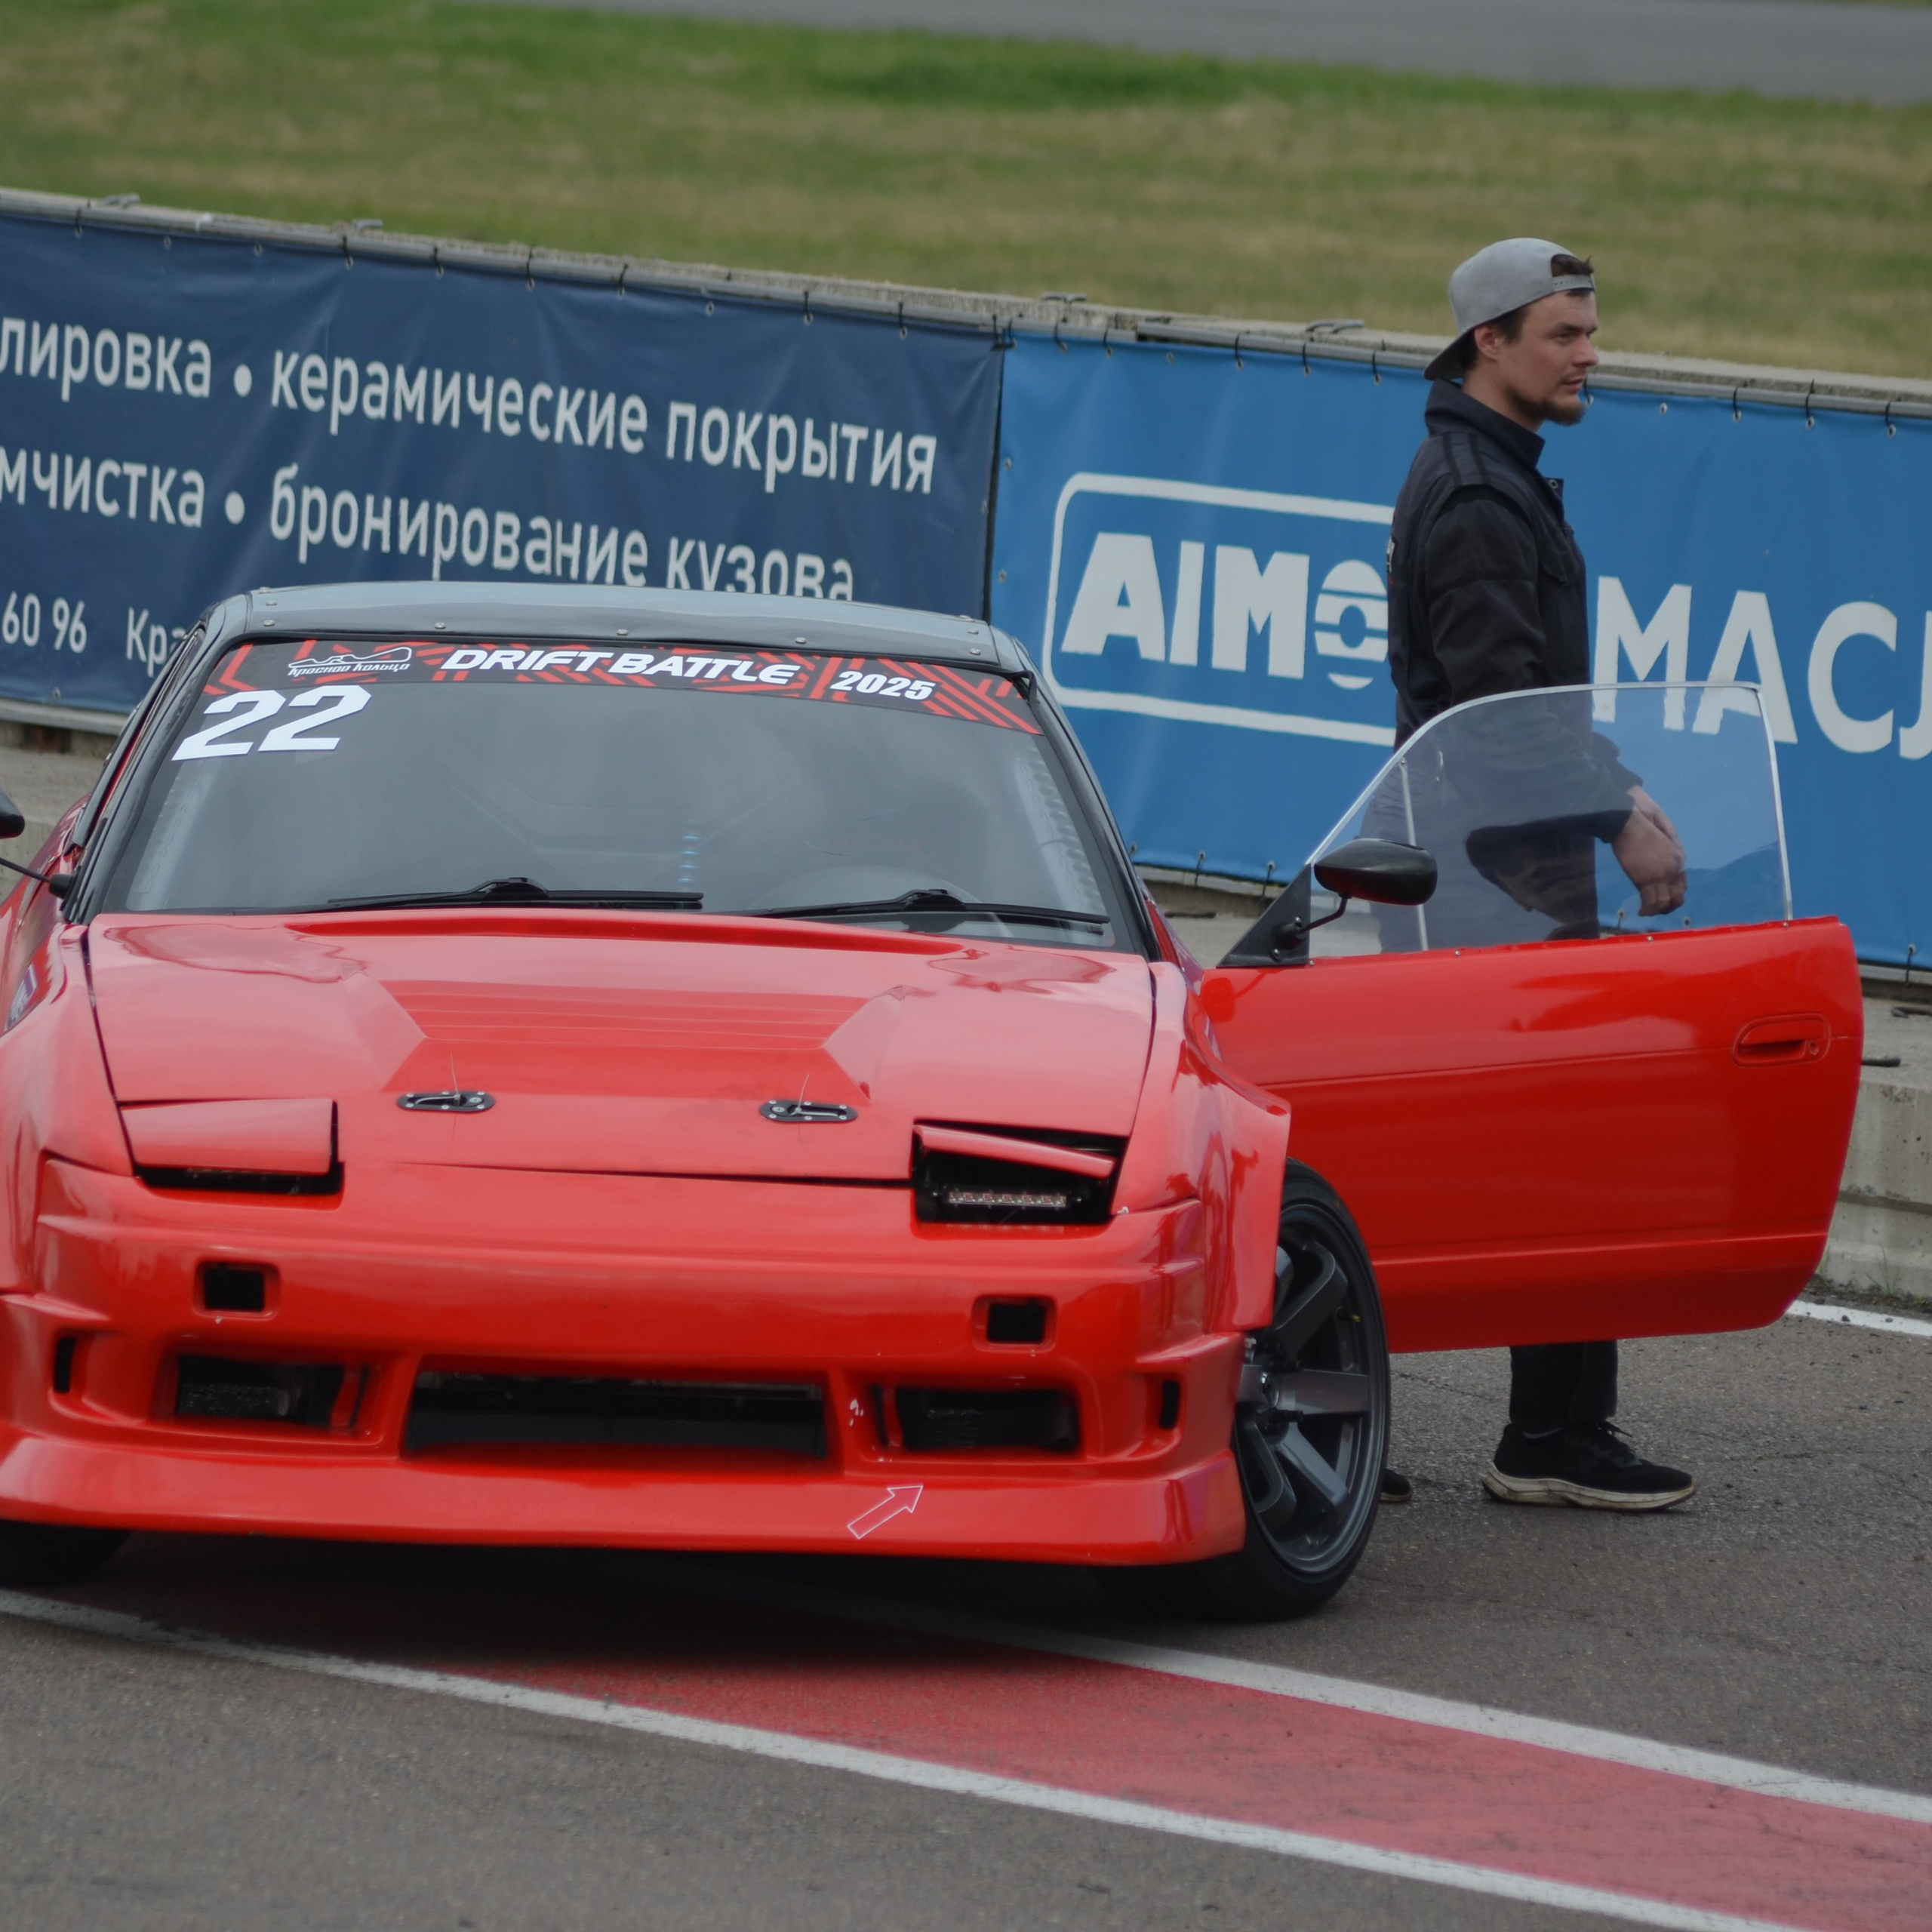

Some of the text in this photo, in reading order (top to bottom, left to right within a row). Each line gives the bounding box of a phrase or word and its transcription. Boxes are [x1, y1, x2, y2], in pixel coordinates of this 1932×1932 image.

[270, 350, 648, 454] керамические
[666, 401, 938, 494] покрытия
[269, 463, 649, 582] бронирование
[666, 537, 854, 601] кузова
[2, 591, 41, 647] 60
[53, 598, 88, 654] 96
[440, 649, 801, 685] DRIFT BATTLE
[829, 669, 937, 701] 2025
[171, 685, 372, 761] 22
